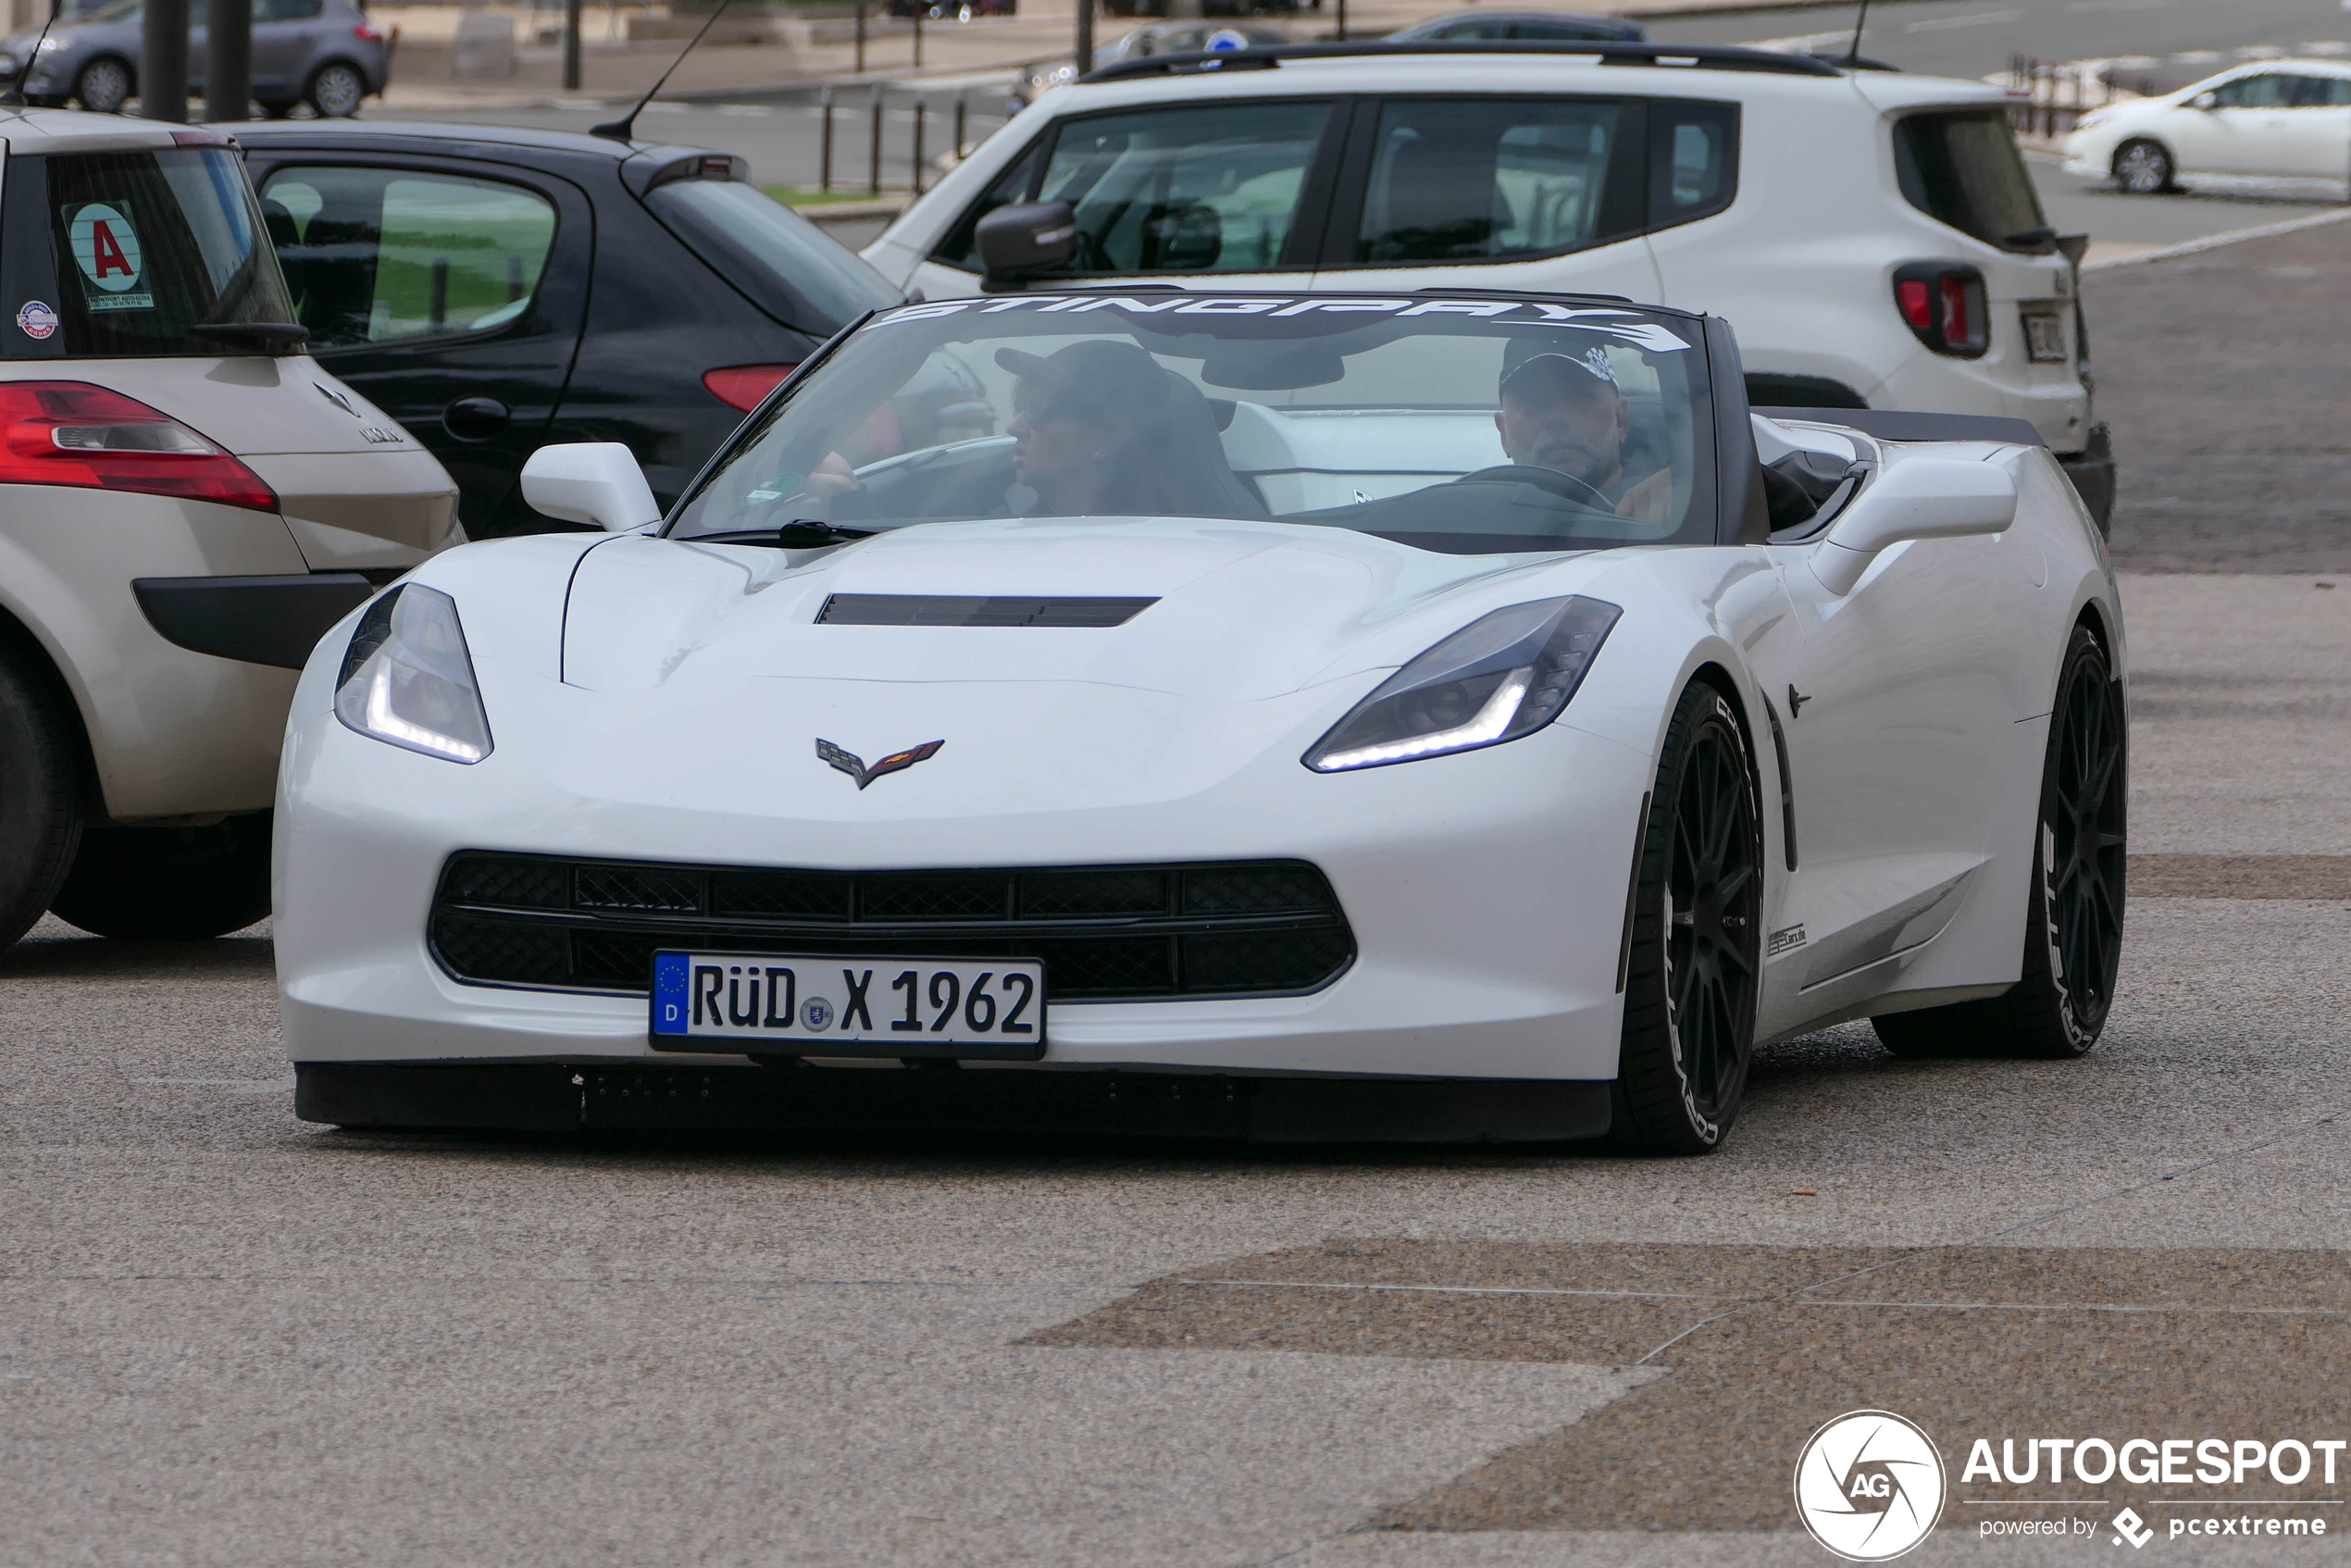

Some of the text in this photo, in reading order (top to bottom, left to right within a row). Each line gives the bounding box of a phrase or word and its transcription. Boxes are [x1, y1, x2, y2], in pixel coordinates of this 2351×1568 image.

[93, 219, 134, 279] A
[861, 296, 1644, 332] STINGRAY
[2043, 820, 2094, 1052] CORVETTE
[665, 1003, 678, 1022] D
[840, 968, 873, 1031] X
[890, 970, 1034, 1034] 1962
